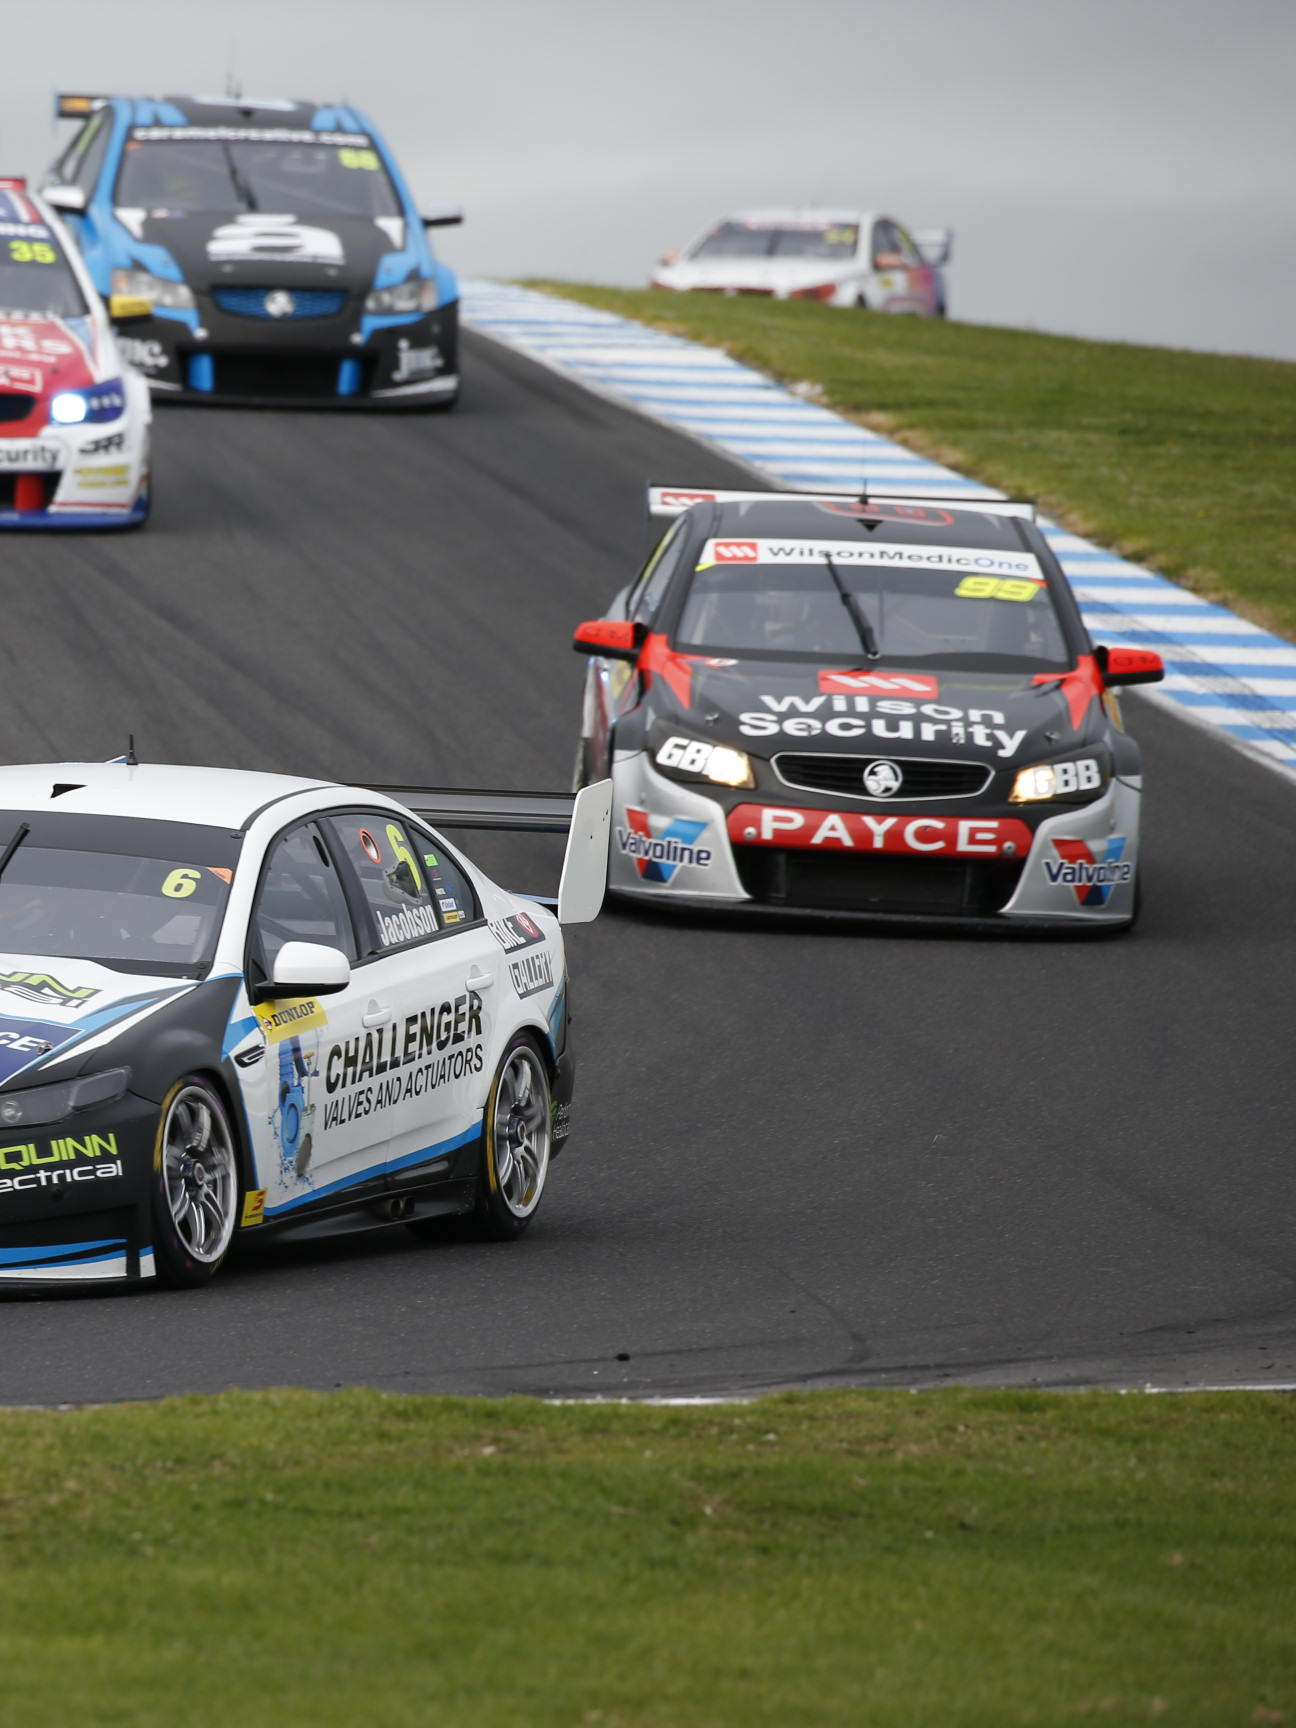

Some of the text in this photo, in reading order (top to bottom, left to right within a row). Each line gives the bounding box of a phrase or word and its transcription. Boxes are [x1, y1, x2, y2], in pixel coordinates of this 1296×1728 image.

[9, 240, 56, 264] 35
[767, 546, 1030, 572] WilsonMedicOne
[759, 694, 1006, 724] Wilson
[738, 712, 1028, 757] Security
[616, 827, 712, 869] Valvoline
[760, 808, 1000, 853] PAYCE
[161, 868, 202, 898] 6
[376, 903, 439, 946] Jacobson
[272, 1001, 316, 1027] DUNLOP
[325, 990, 483, 1094] CHALLENGER
[323, 1043, 484, 1131] VALVES AND ACTUATORS
